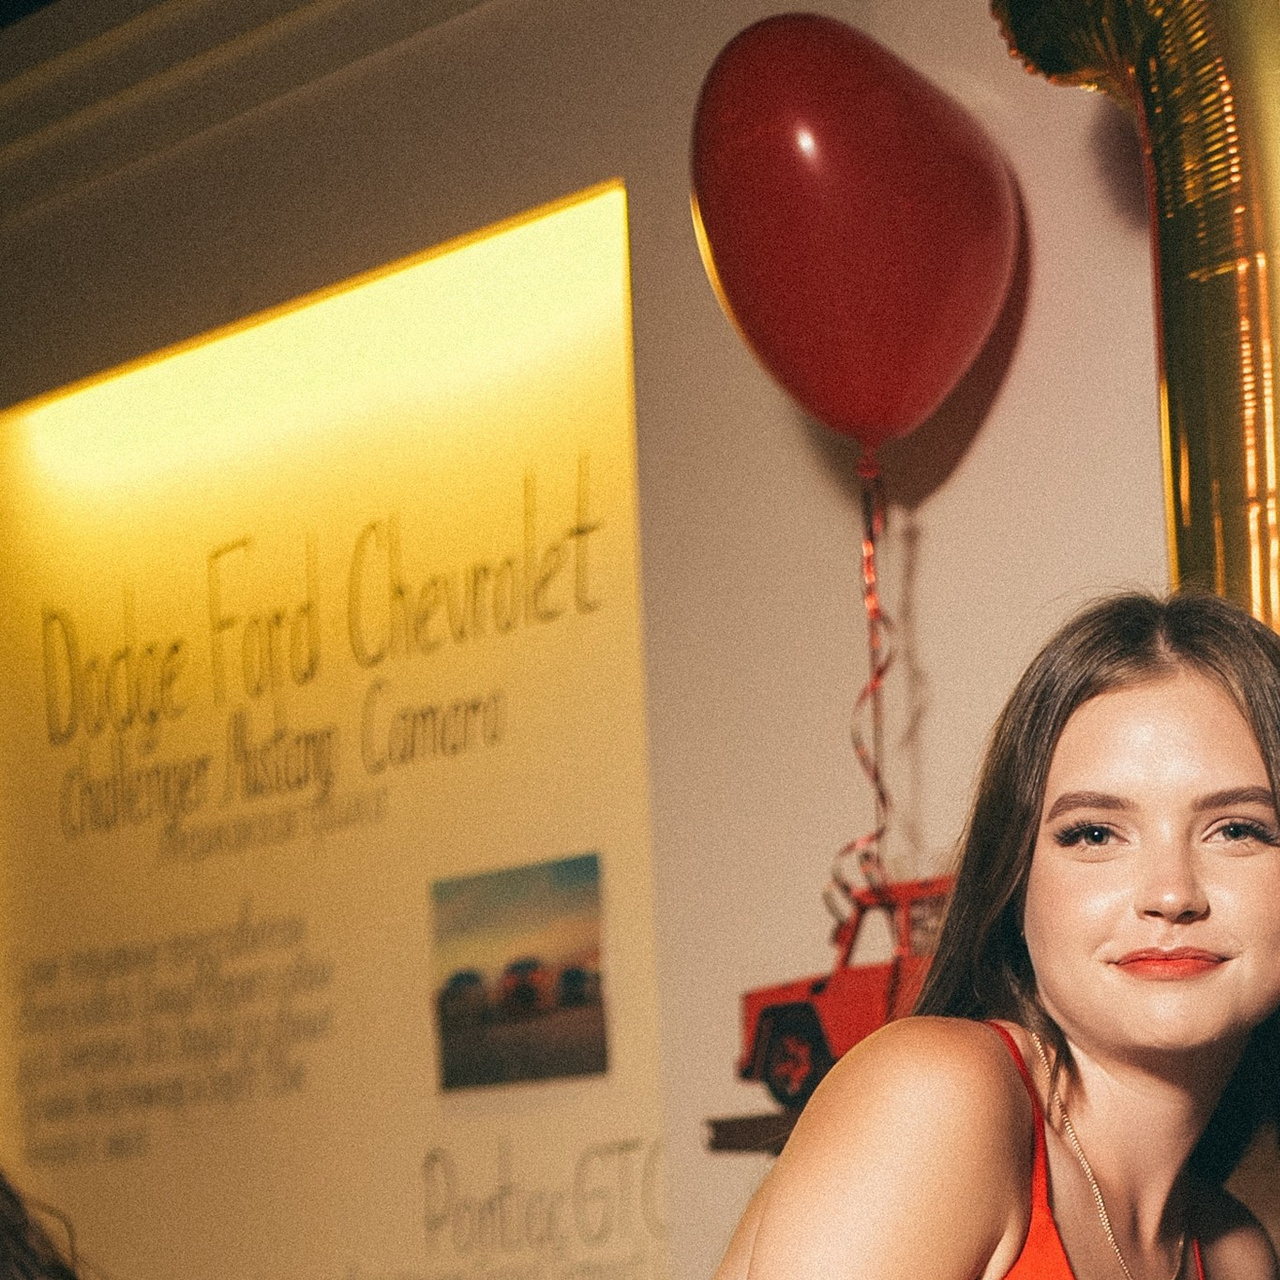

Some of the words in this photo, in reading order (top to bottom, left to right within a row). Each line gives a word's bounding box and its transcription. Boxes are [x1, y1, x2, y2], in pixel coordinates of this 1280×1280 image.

[39, 581, 188, 754] Dodge
[207, 529, 323, 710] Ford
[346, 454, 604, 670] Chevrolet
